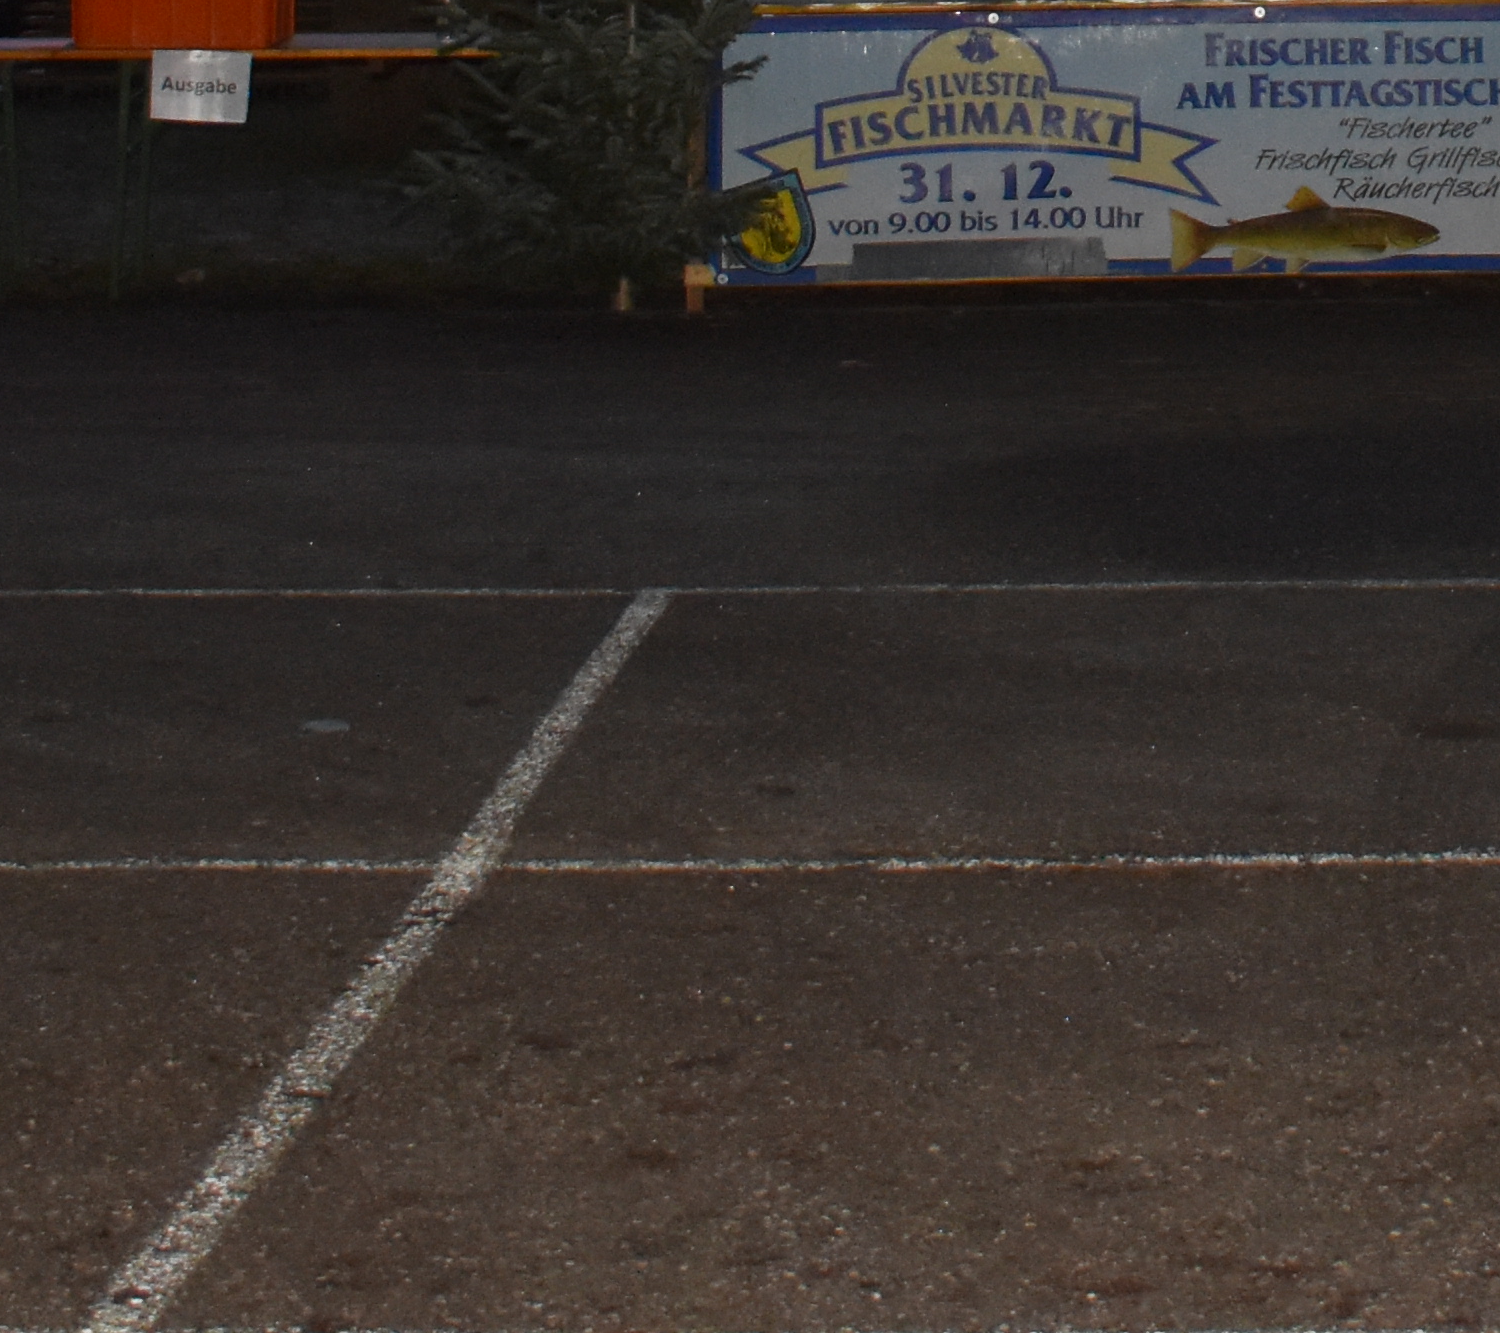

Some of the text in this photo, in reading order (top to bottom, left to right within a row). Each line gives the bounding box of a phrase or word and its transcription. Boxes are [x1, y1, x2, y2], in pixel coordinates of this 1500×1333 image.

[1204, 30, 1485, 67] FRISCHER FISCH
[161, 76, 238, 97] Ausgabe
[907, 71, 1050, 104] SILVESTER
[1176, 80, 1237, 110] AM
[826, 102, 1134, 155] FISCHMARKT
[1254, 147, 1397, 176] Frischfisch
[1333, 176, 1500, 205] Räucherfisch
[828, 206, 1145, 237] von 9.00 bis 14.00 Uhr
